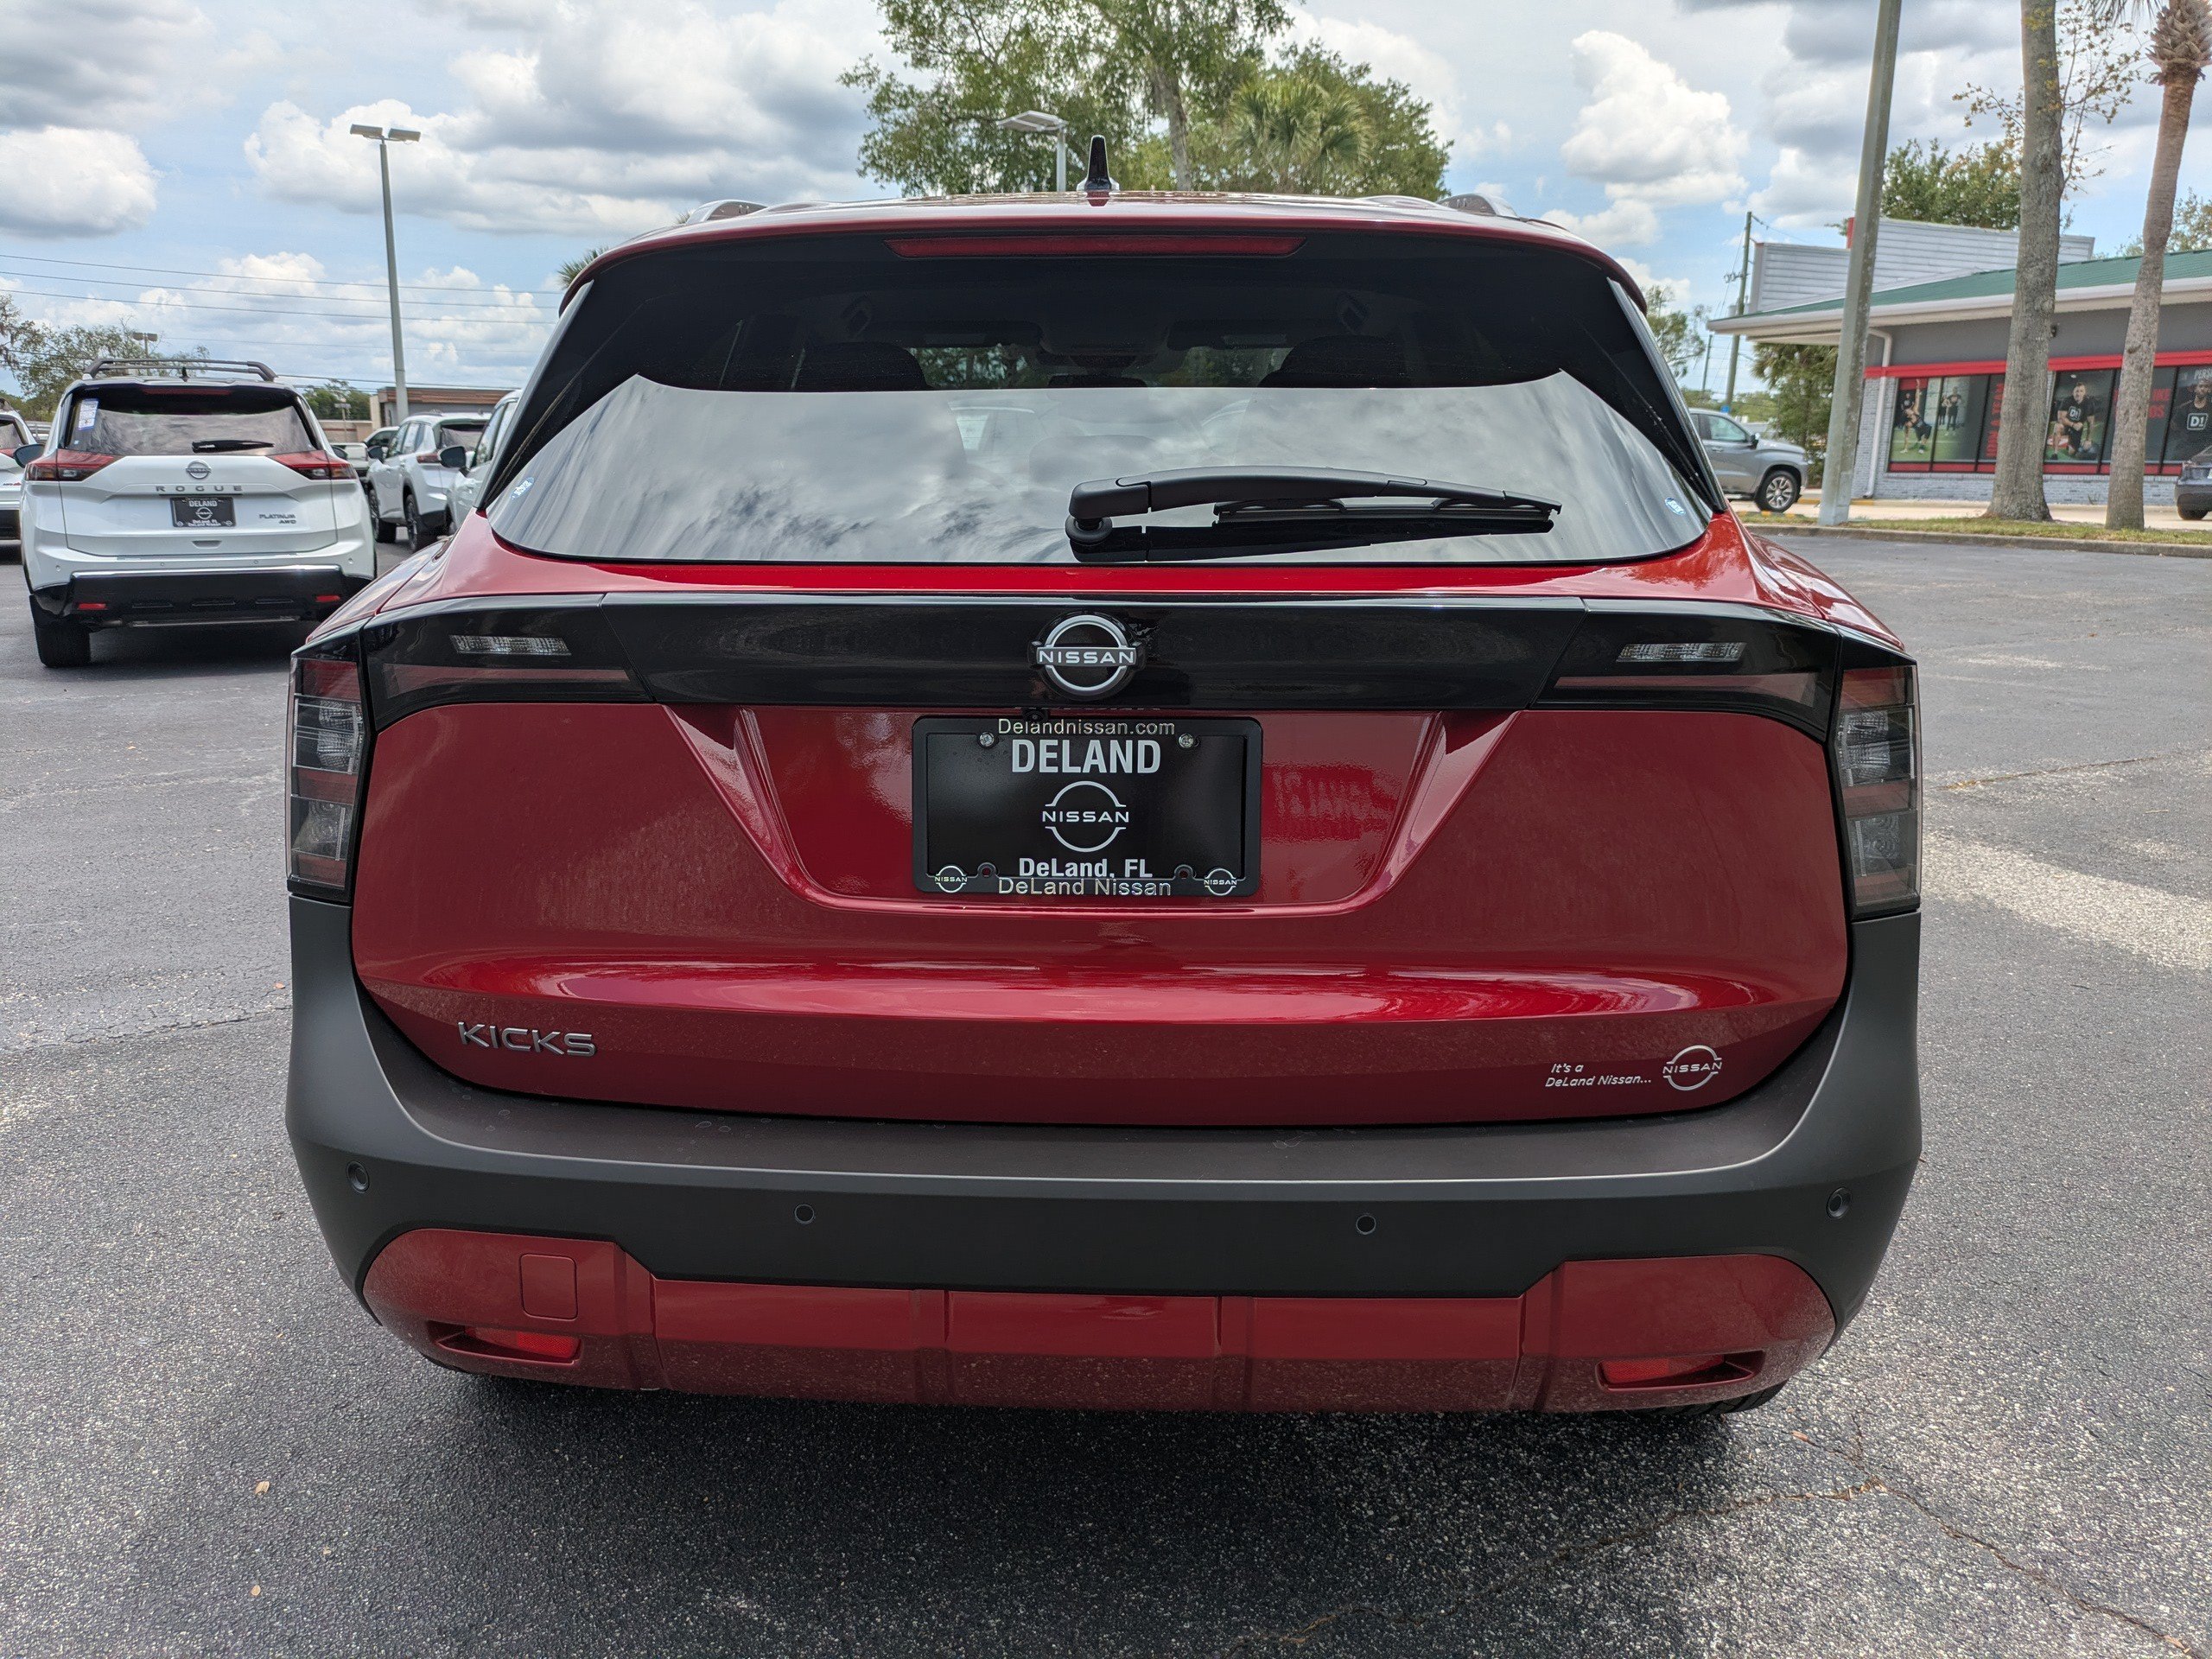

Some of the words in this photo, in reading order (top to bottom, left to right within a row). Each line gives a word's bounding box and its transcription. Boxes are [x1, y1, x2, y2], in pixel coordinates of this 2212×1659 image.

[1039, 651, 1135, 664] NISSAN
[998, 718, 1175, 735] Delandnissan.com
[1012, 739, 1160, 774] DELAND
[1042, 810, 1129, 823] NISSAN
[1124, 858, 1153, 878] FL
[998, 876, 1084, 895] DeLand
[1095, 878, 1172, 896] Nissan
[457, 1021, 597, 1057] KICKS
[1551, 1063, 1571, 1074] It's
[1574, 1065, 1584, 1074] a
[1662, 1061, 1723, 1075] NISSAN
[1545, 1076, 1596, 1088] DeLand
[1598, 1074, 1652, 1086] Nissan...
